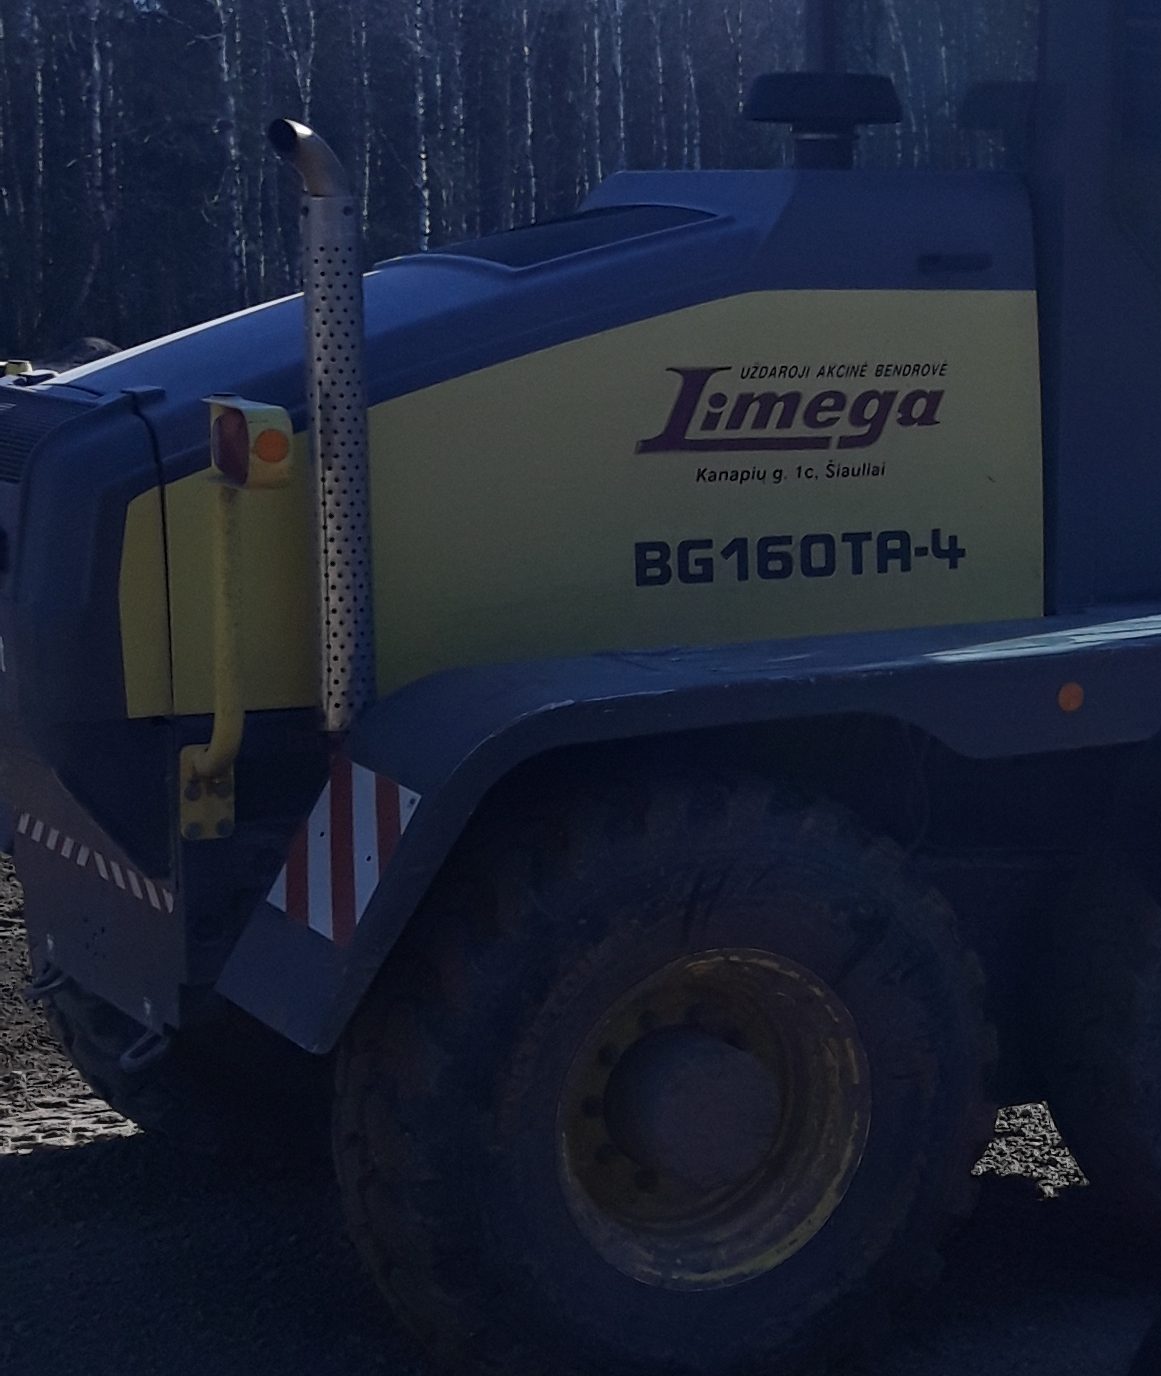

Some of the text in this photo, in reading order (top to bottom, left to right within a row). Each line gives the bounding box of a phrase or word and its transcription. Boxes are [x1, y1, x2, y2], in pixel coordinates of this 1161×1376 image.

[740, 362, 948, 380] UŽDAROJI AKCINĖ BENDROVĖ
[634, 366, 945, 455] Limega
[826, 460, 886, 479] Šiauliai
[634, 528, 967, 587] BG160TA-4
